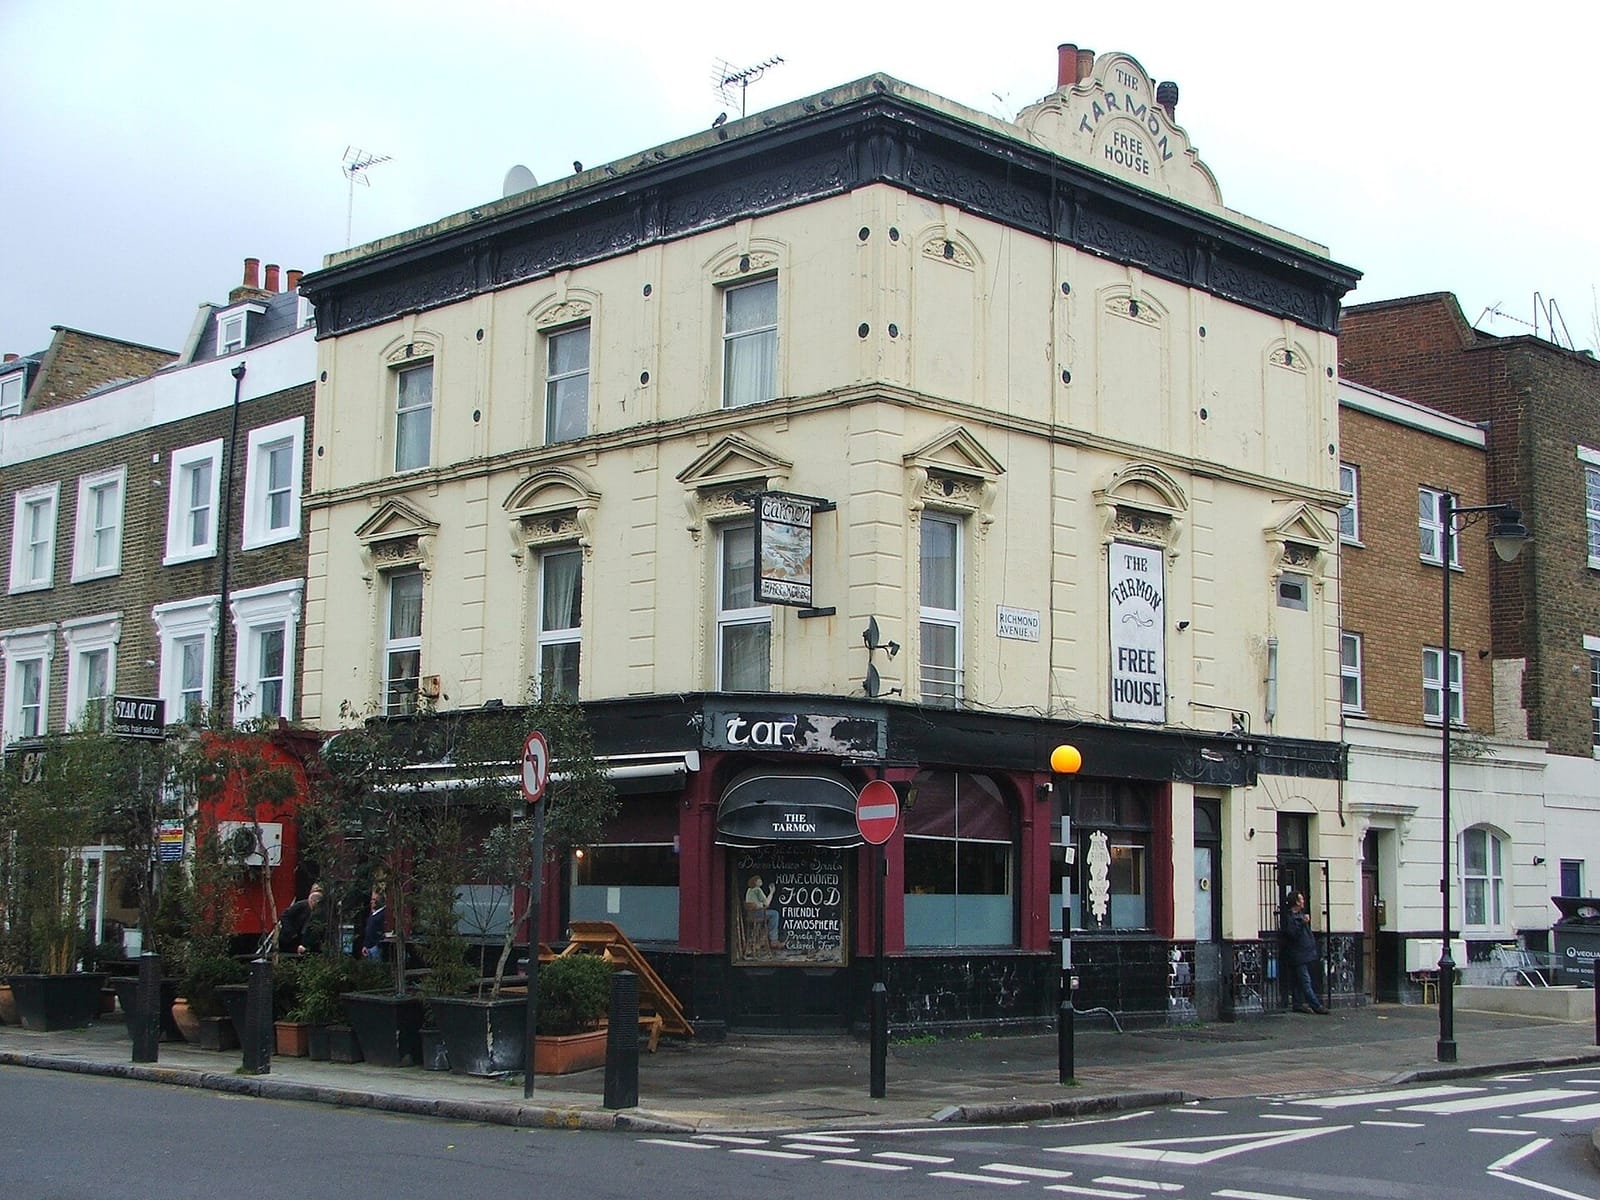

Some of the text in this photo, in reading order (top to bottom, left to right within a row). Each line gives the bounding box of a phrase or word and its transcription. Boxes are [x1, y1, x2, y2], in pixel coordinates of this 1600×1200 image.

[1115, 68, 1139, 91] THE
[1079, 92, 1173, 161] TARMON
[1113, 131, 1143, 156] FREE
[1104, 145, 1149, 175] HOUSE
[1124, 555, 1148, 572] THE
[1111, 578, 1162, 611] TARMON
[1000, 612, 1039, 628] RICHMOND
[1118, 647, 1156, 674] FREE
[1114, 678, 1162, 706] HOUSE
[114, 700, 157, 720] STAR CUT
[772, 823, 816, 833] TARMON
[784, 813, 806, 823] THE
[779, 887, 840, 905] FOOD
[782, 906, 821, 918] FRIENDLY
[783, 919, 839, 931] ATMOSPHERE
